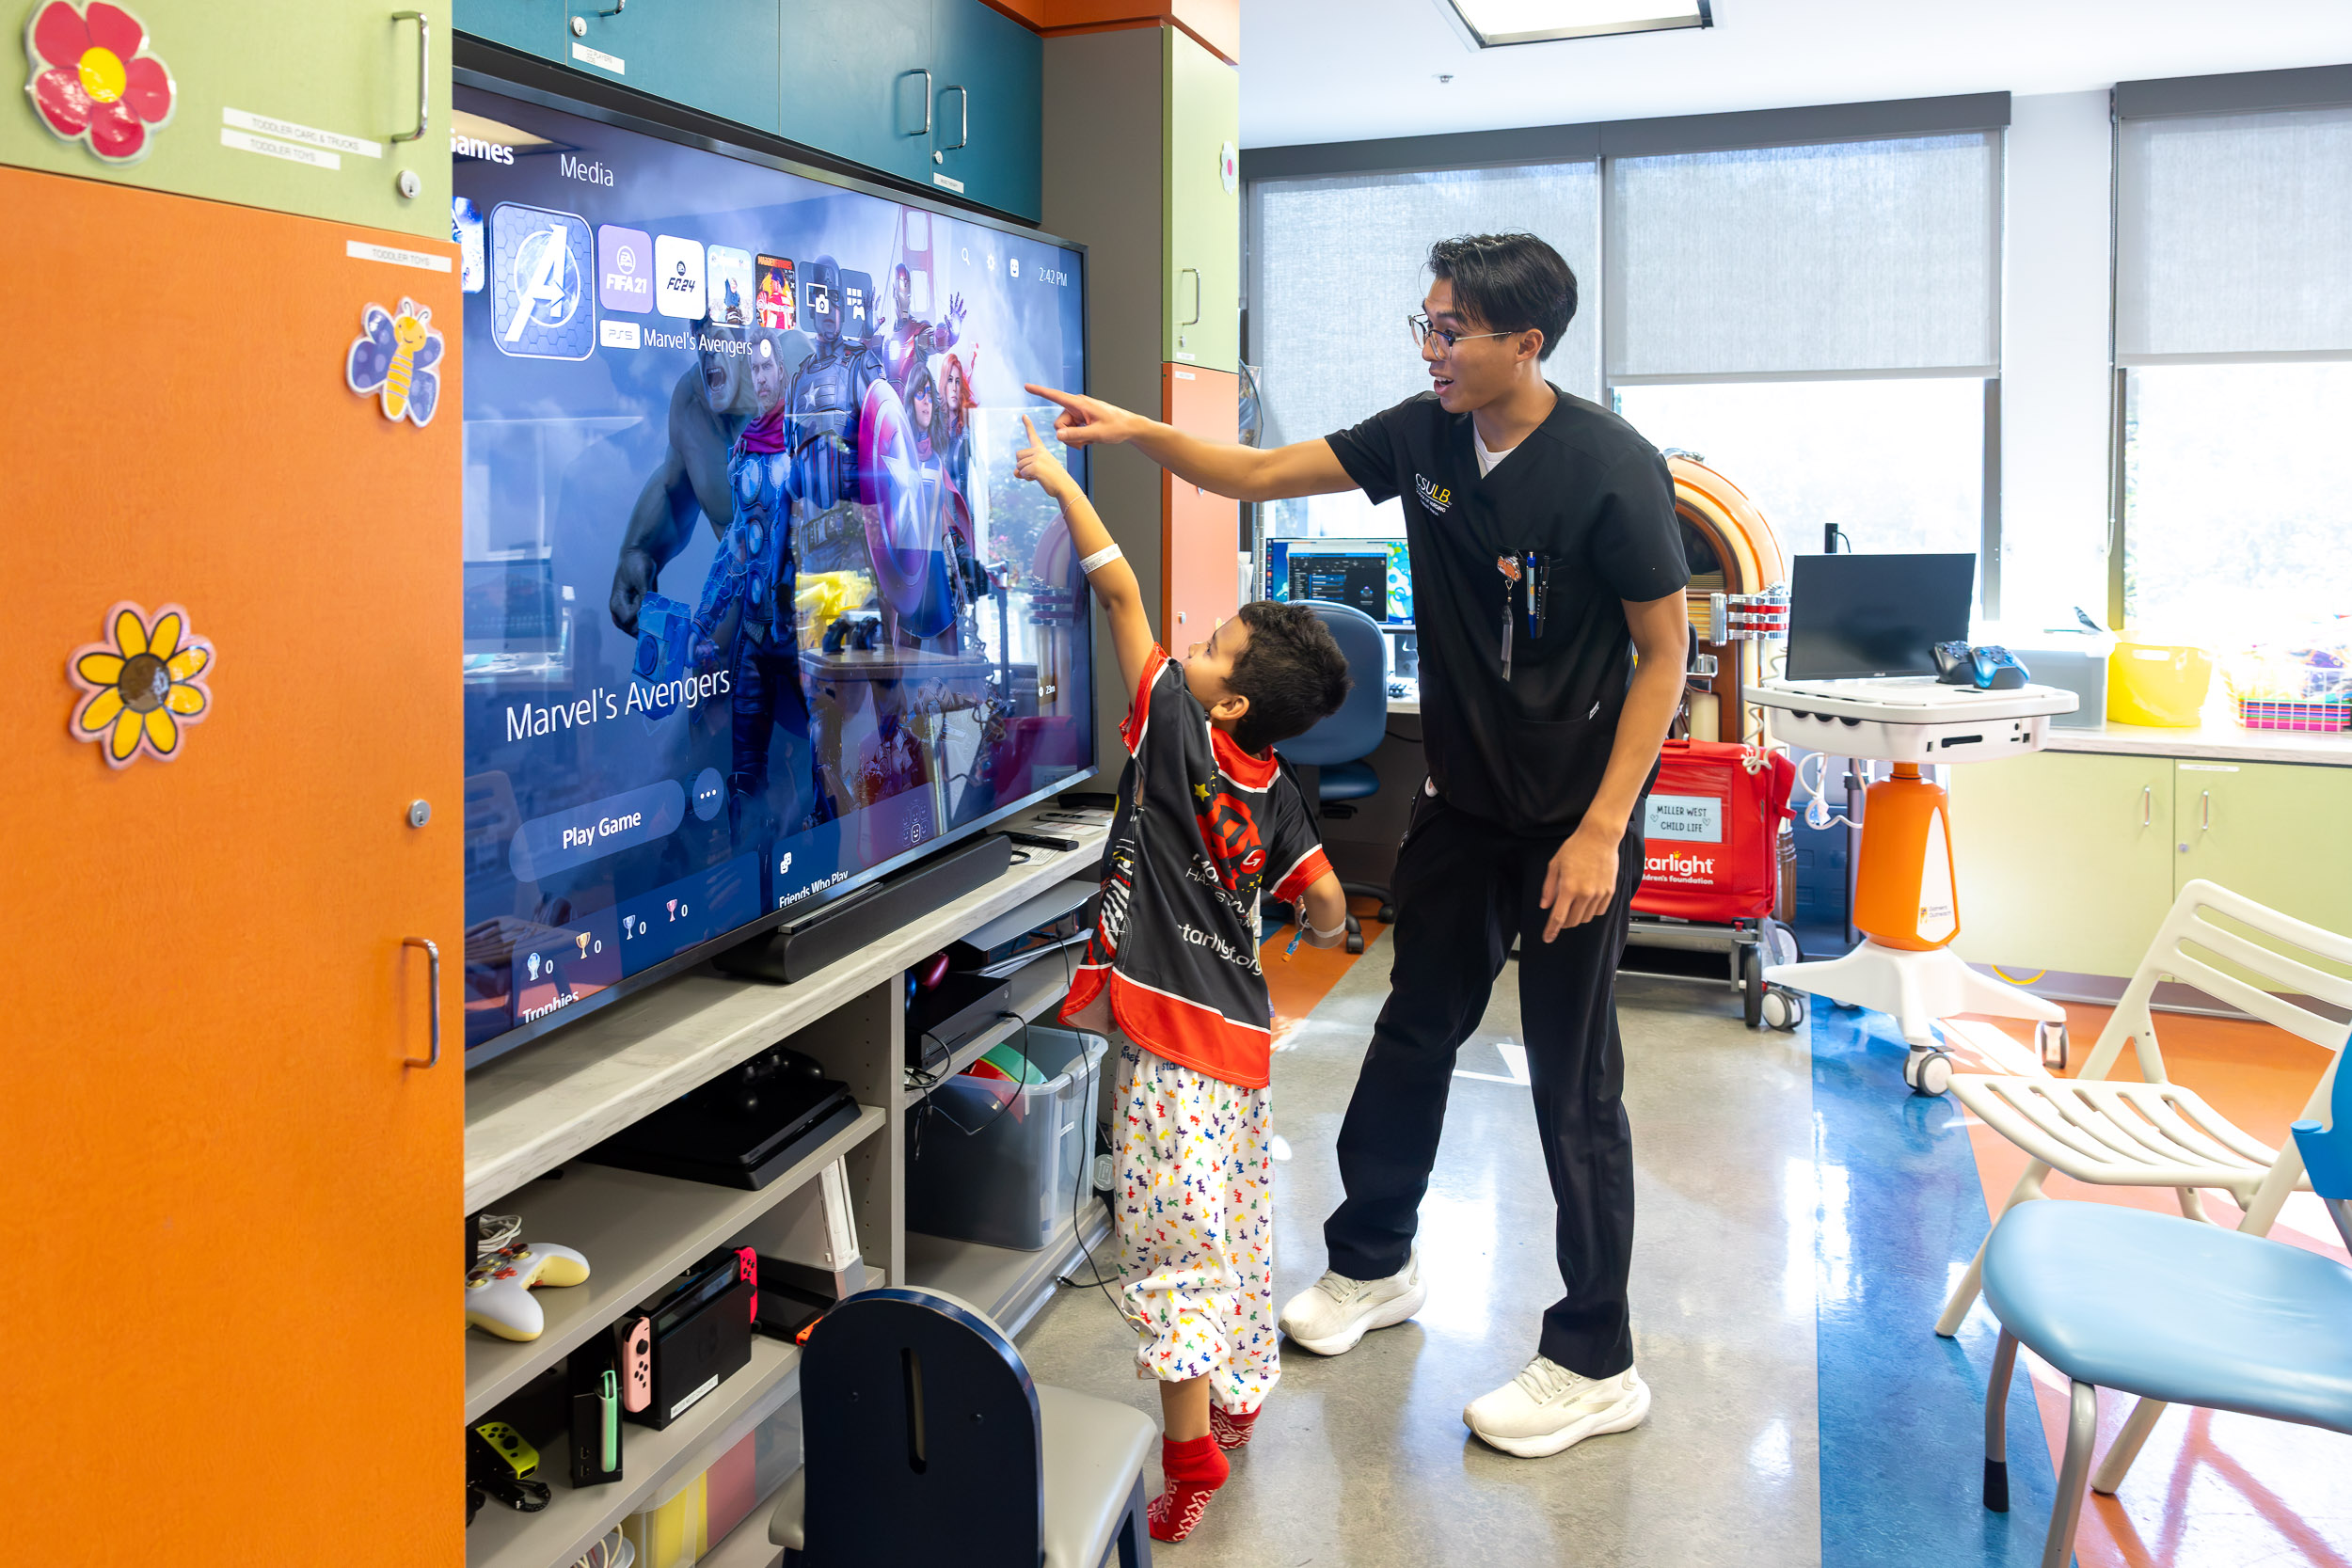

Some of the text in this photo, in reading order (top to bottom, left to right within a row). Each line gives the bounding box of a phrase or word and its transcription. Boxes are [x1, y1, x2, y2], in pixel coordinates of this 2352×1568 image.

[251, 118, 293, 135] TODDLER
[250, 138, 317, 163] TODDLER TOYS
[451, 128, 515, 166] ames
[560, 153, 614, 187] Media
[372, 248, 430, 266] TODDLER TOYS
[1039, 267, 1067, 286] 2:42 PM
[644, 328, 753, 357] Marvel's Avengers
[1416, 473, 1451, 503] CSULB
[506, 670, 730, 741] Marvel's Avengers
[1656, 805, 1707, 817] MILLER WEST
[563, 812, 642, 850] Play Game
[1661, 821, 1703, 832] CHILD LIFE
[1645, 853, 1713, 877] tarlight
[1669, 875, 1714, 885] foundation
[779, 886, 810, 908] Friends
[811, 879, 831, 894] Who
[681, 904, 689, 917] 0
[639, 921, 647, 935] 0
[594, 940, 602, 954] 0
[545, 959, 553, 974] 0
